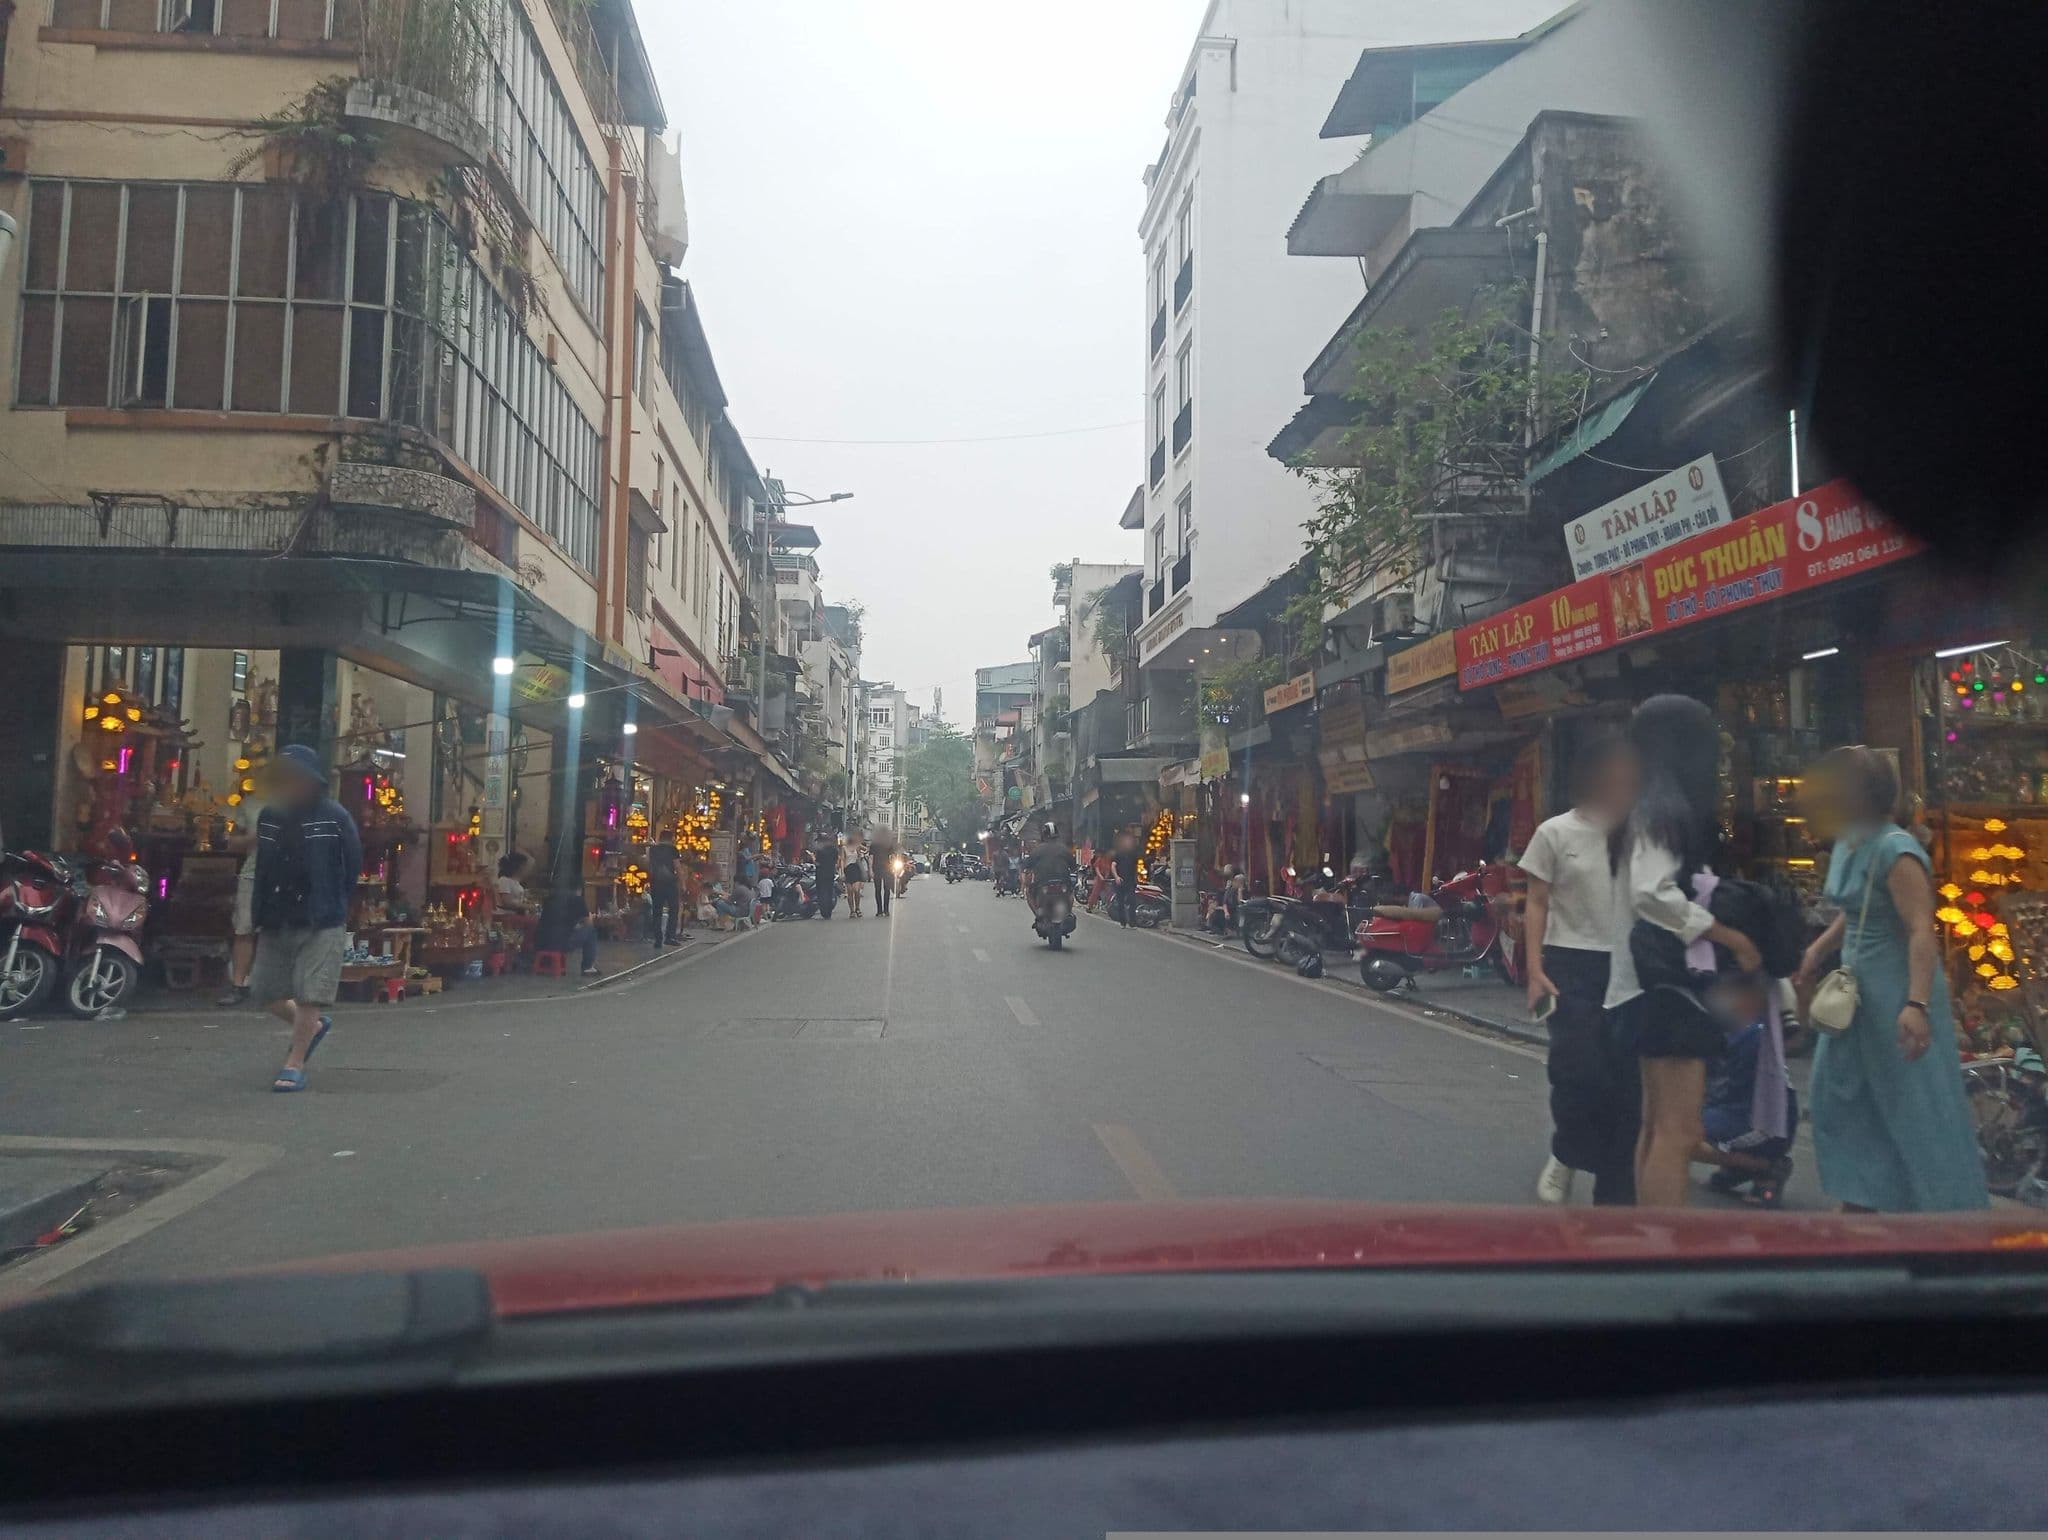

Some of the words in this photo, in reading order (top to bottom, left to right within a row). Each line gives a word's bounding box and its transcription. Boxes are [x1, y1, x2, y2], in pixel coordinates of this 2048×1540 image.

[1601, 508, 1640, 541] TÂN
[1640, 489, 1678, 525] LẬP
[1796, 500, 1824, 552] 8
[1824, 505, 1864, 543] HÀNG
[1653, 556, 1698, 599] ĐỨC
[1719, 576, 1755, 608] PHONG
[1469, 623, 1500, 658] TÂN
[1502, 612, 1535, 650] LẬP
[1550, 595, 1571, 632] 10
